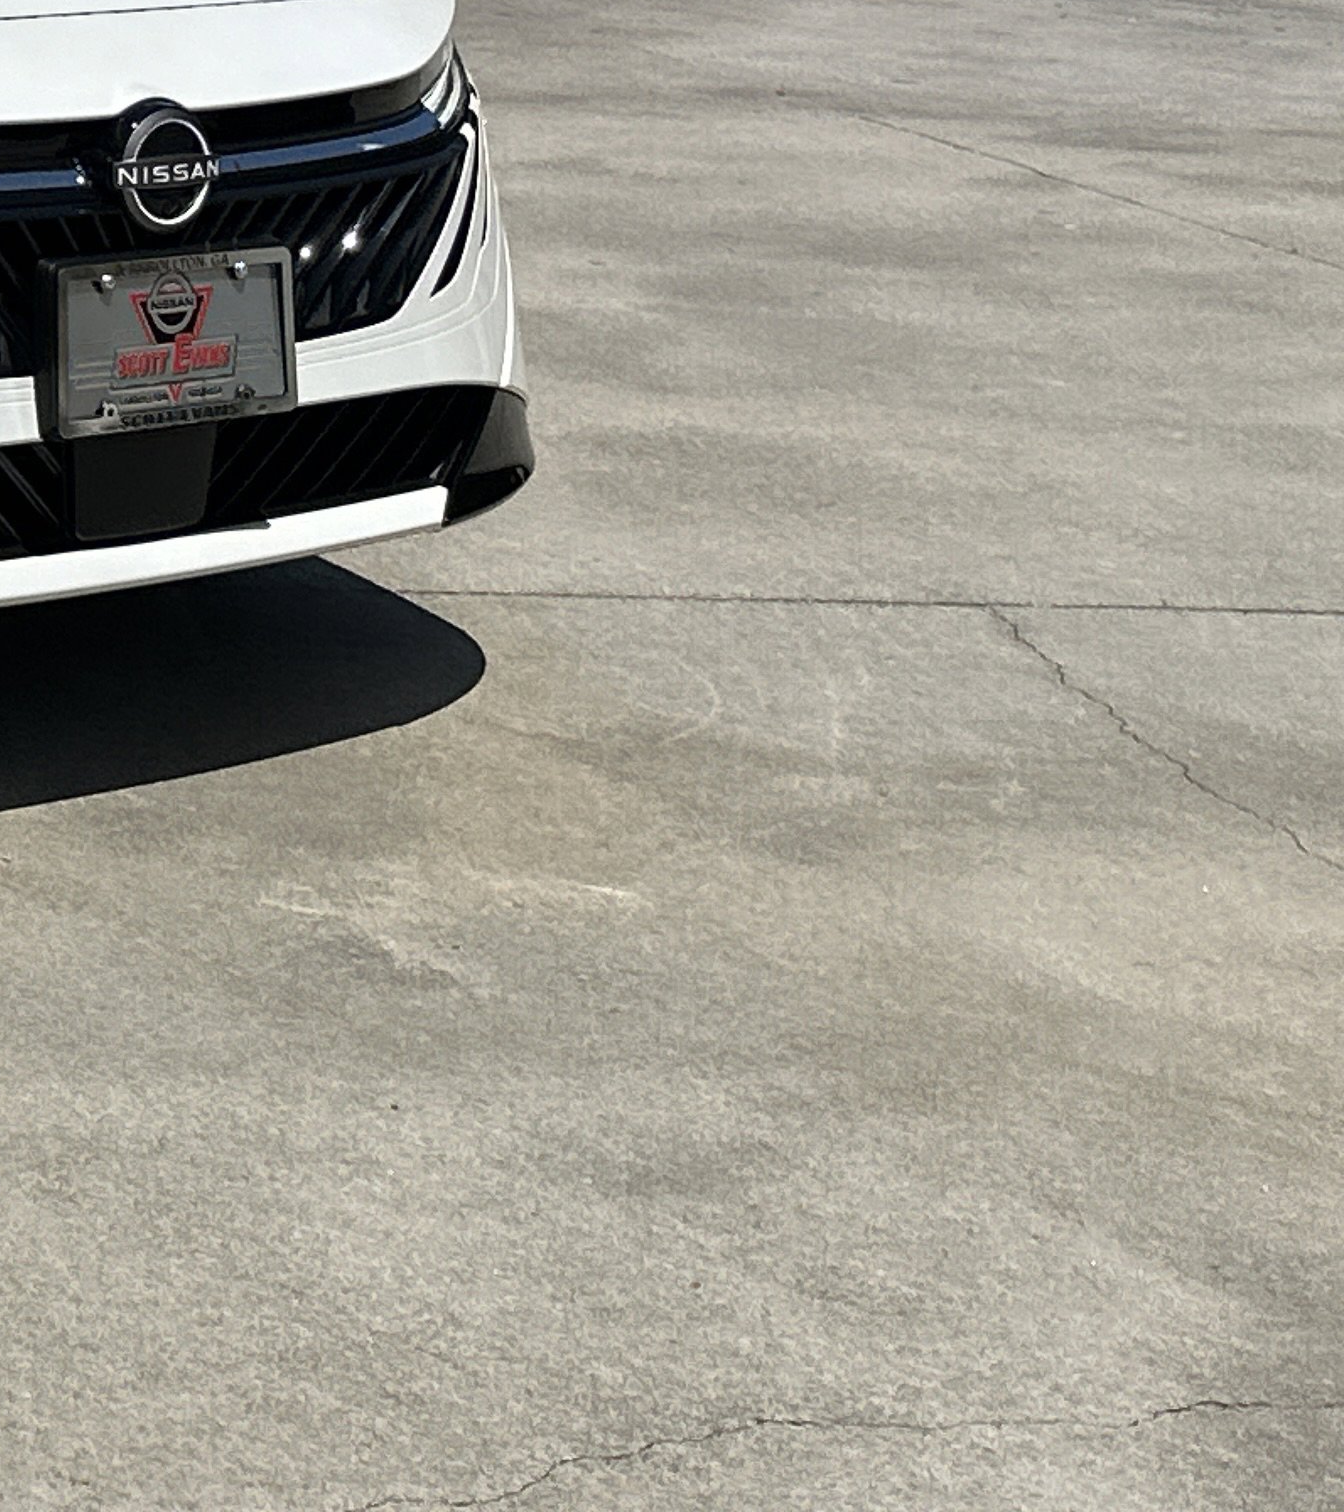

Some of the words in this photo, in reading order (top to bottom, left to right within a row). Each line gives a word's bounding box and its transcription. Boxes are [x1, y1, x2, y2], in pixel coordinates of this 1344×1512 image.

[117, 160, 220, 186] NISSAN
[150, 296, 195, 311] NISSAN
[118, 349, 169, 378] SCOTT
